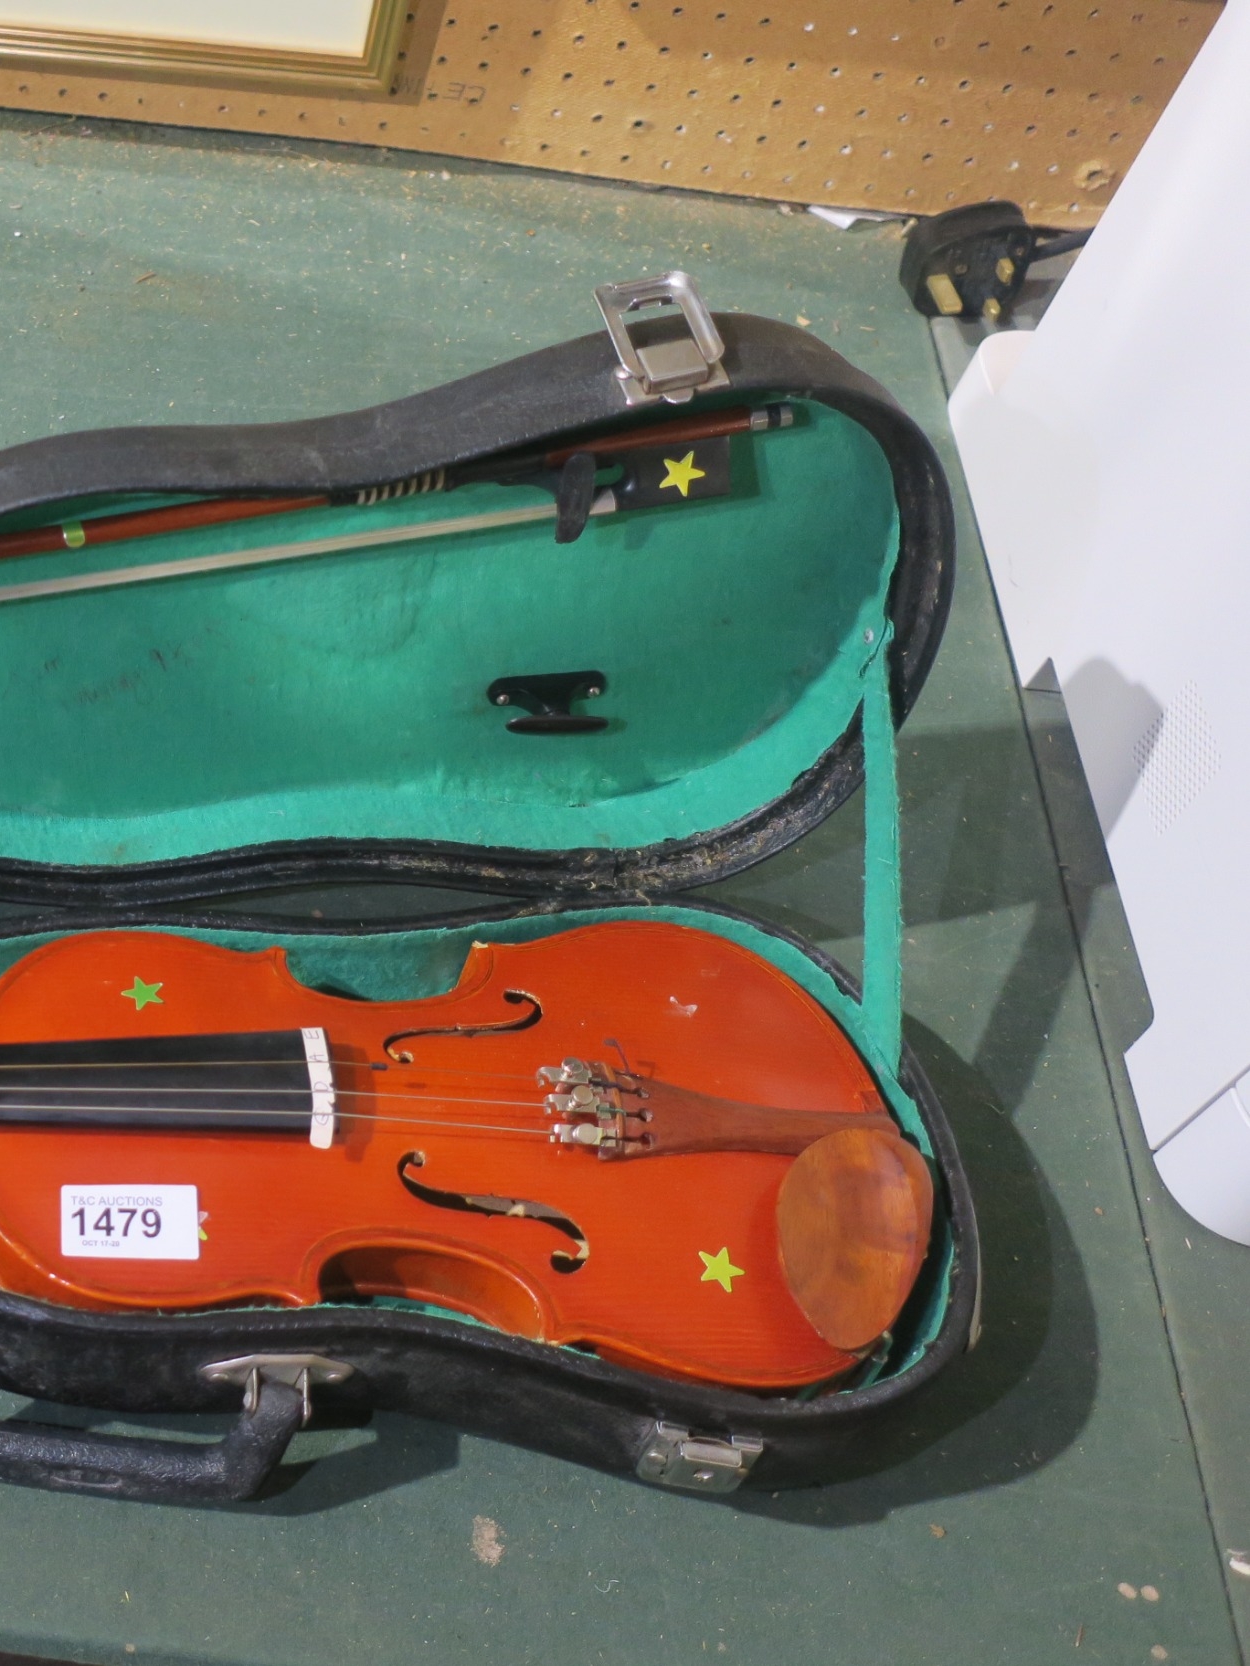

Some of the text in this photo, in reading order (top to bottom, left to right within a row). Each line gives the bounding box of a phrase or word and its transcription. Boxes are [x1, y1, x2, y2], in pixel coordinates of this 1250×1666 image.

[304, 1030, 320, 1040] E
[309, 1052, 324, 1062] A
[314, 1082, 329, 1093] D
[71, 1195, 163, 1207] T&C AUCTIONS
[71, 1207, 162, 1238] 1479
